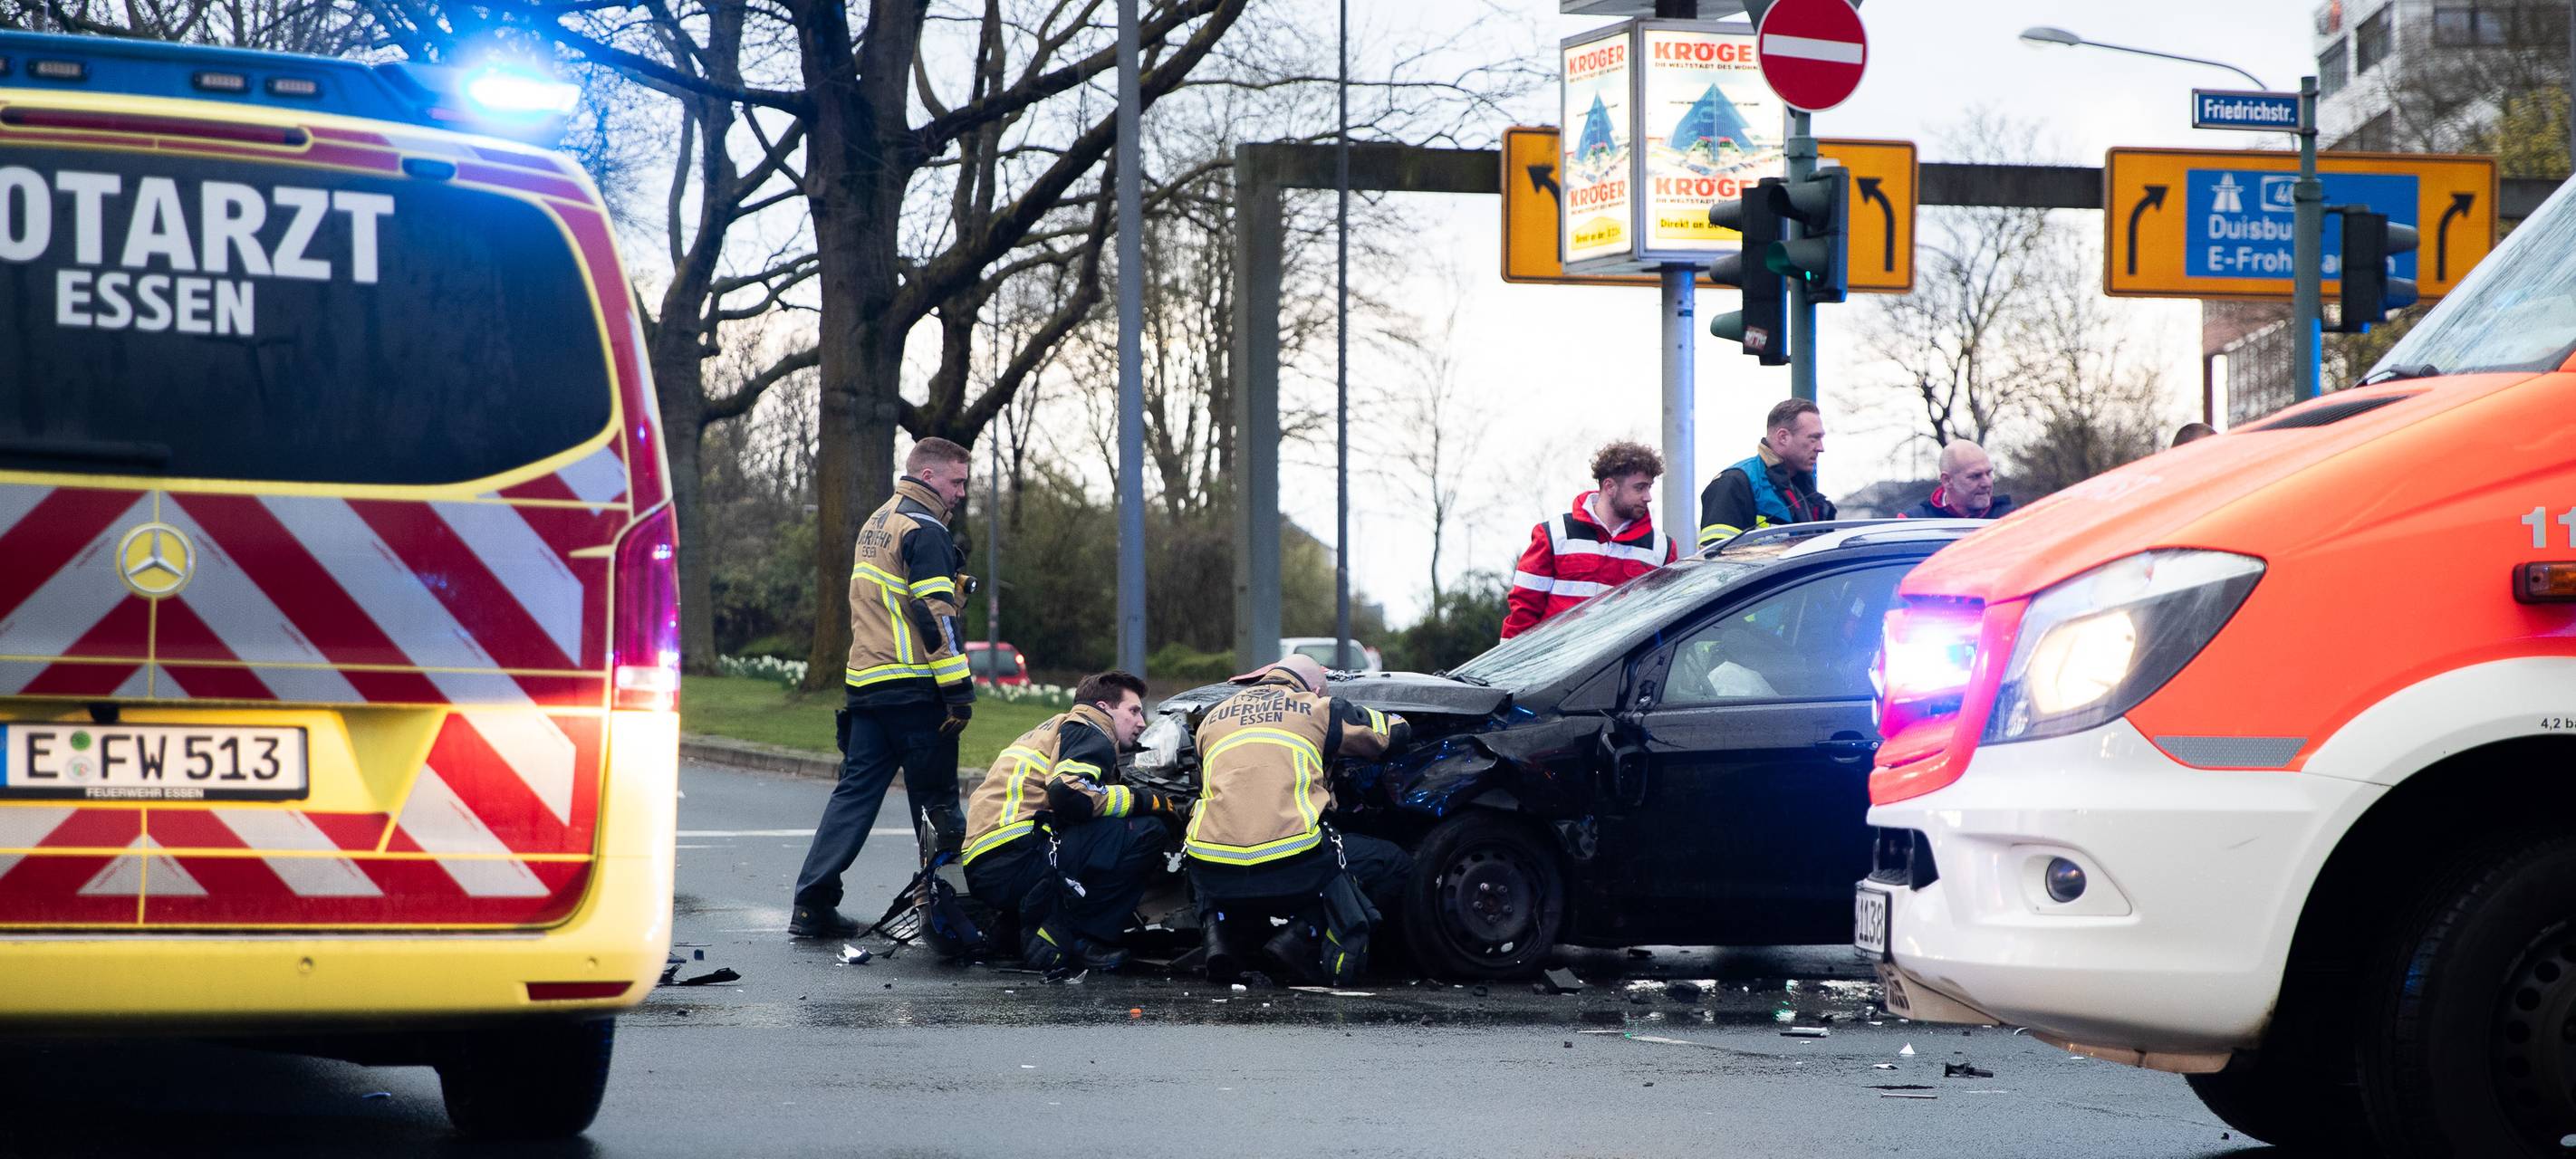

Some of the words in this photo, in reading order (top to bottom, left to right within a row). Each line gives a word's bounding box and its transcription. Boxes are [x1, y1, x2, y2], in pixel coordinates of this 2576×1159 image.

[1570, 44, 1624, 75] KRÖGER
[1654, 41, 1753, 62] KRÖGE
[2204, 99, 2295, 122] Friedrichstr.
[1571, 180, 1625, 207] KRÖGER
[0, 166, 394, 283] OTARZT
[1660, 218, 1689, 228] Direkt
[2208, 214, 2293, 240] Duisbu
[56, 270, 255, 335] ESSEN
[1240, 712, 1283, 725] ESSEN
[2541, 717, 2561, 731] 4,2
[27, 733, 58, 778] E
[101, 734, 167, 780] FW
[185, 736, 281, 781] 513
[86, 787, 162, 798] FEUERWEHR
[164, 788, 205, 798] ESSEN
